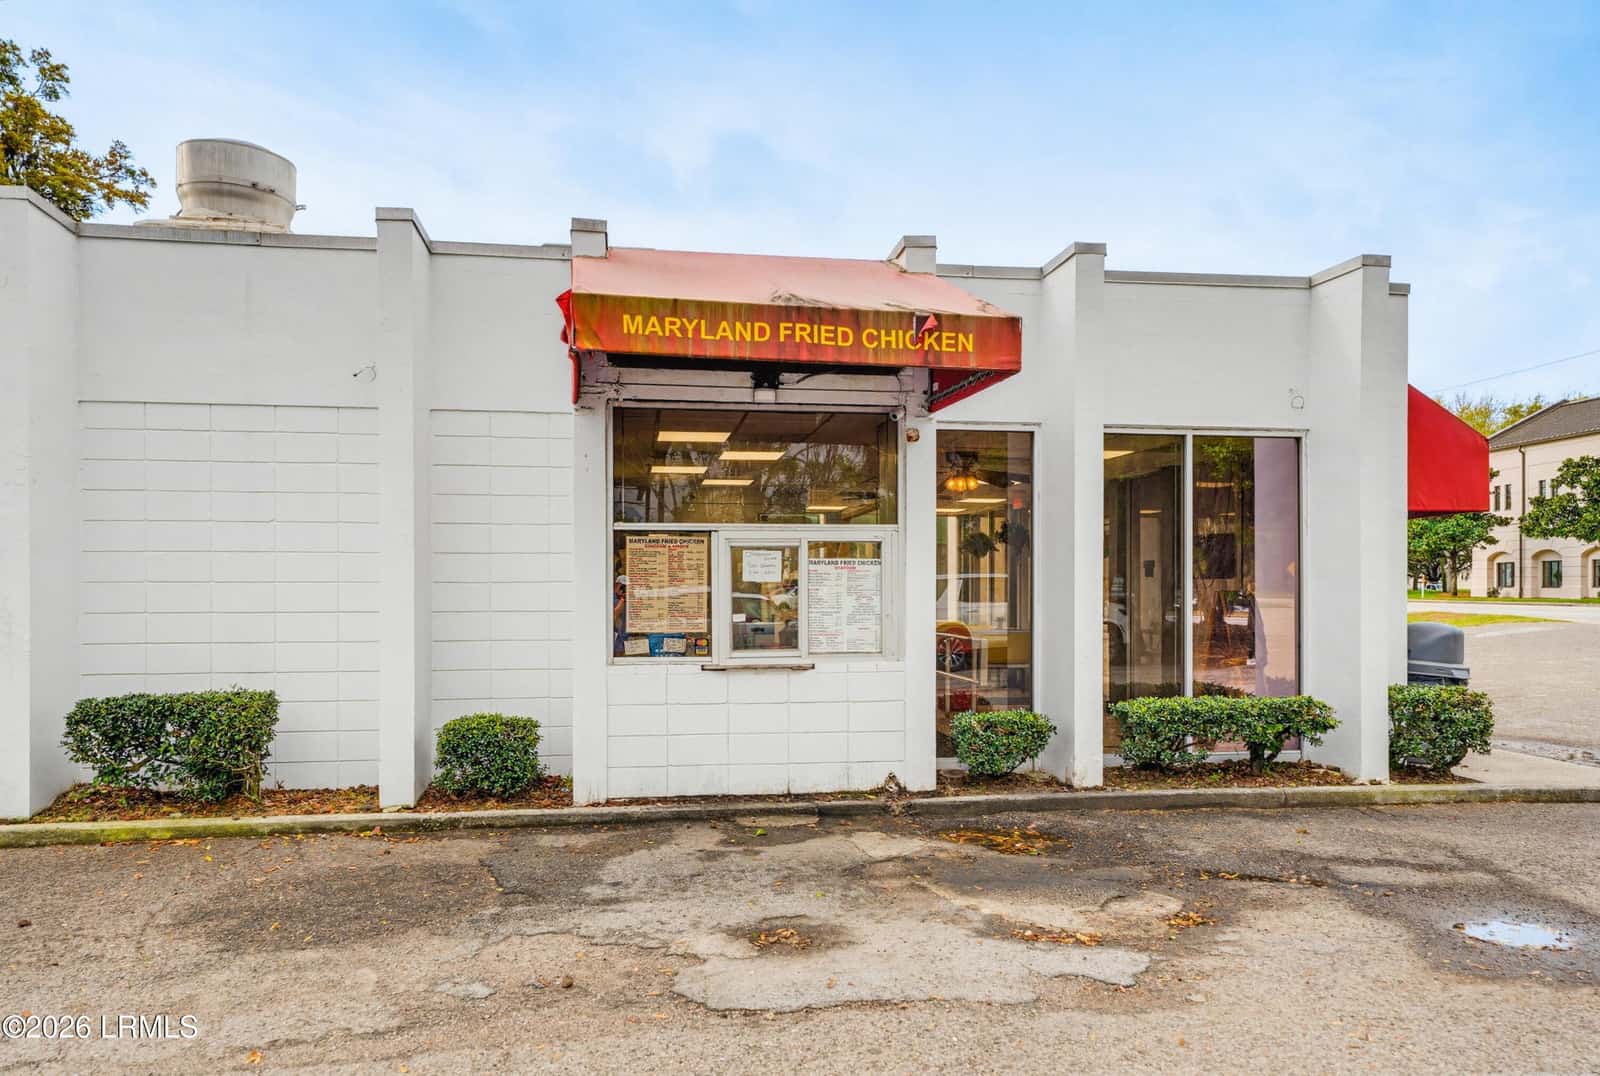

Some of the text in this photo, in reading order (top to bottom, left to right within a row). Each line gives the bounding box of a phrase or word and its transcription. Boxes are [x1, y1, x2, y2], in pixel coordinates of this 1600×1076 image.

[622, 314, 974, 352] MARYLAND FRIED CHICKEN
